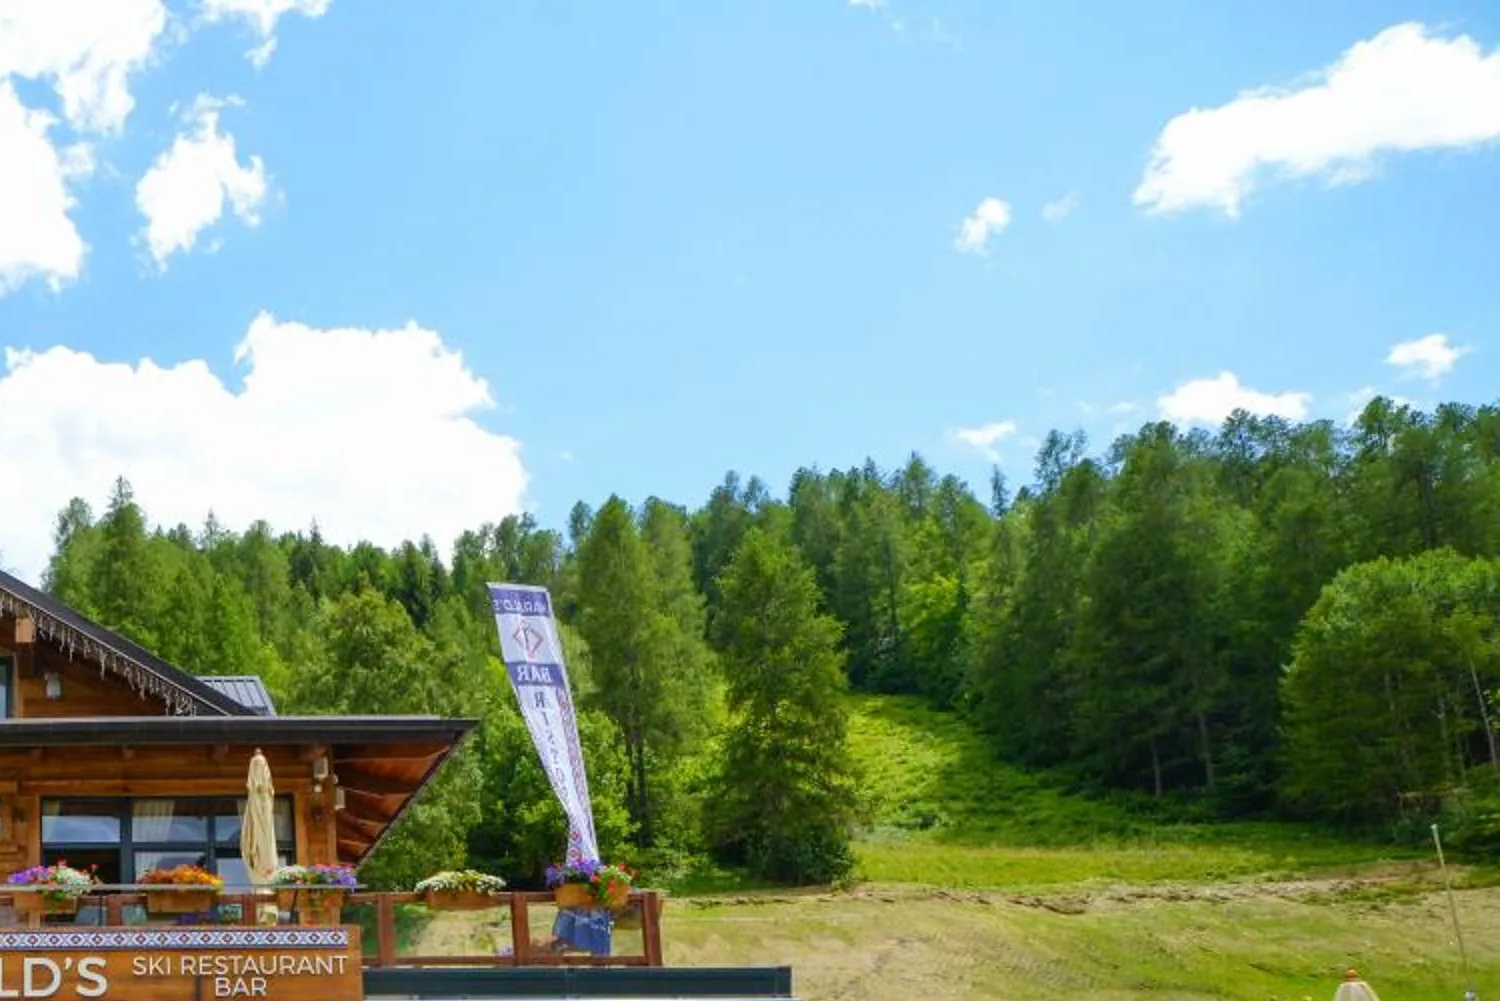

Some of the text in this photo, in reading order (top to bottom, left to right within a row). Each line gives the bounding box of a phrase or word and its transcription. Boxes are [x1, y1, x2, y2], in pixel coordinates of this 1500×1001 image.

[132, 955, 348, 975] SKI RESTAURANT
[215, 977, 267, 997] BAR
